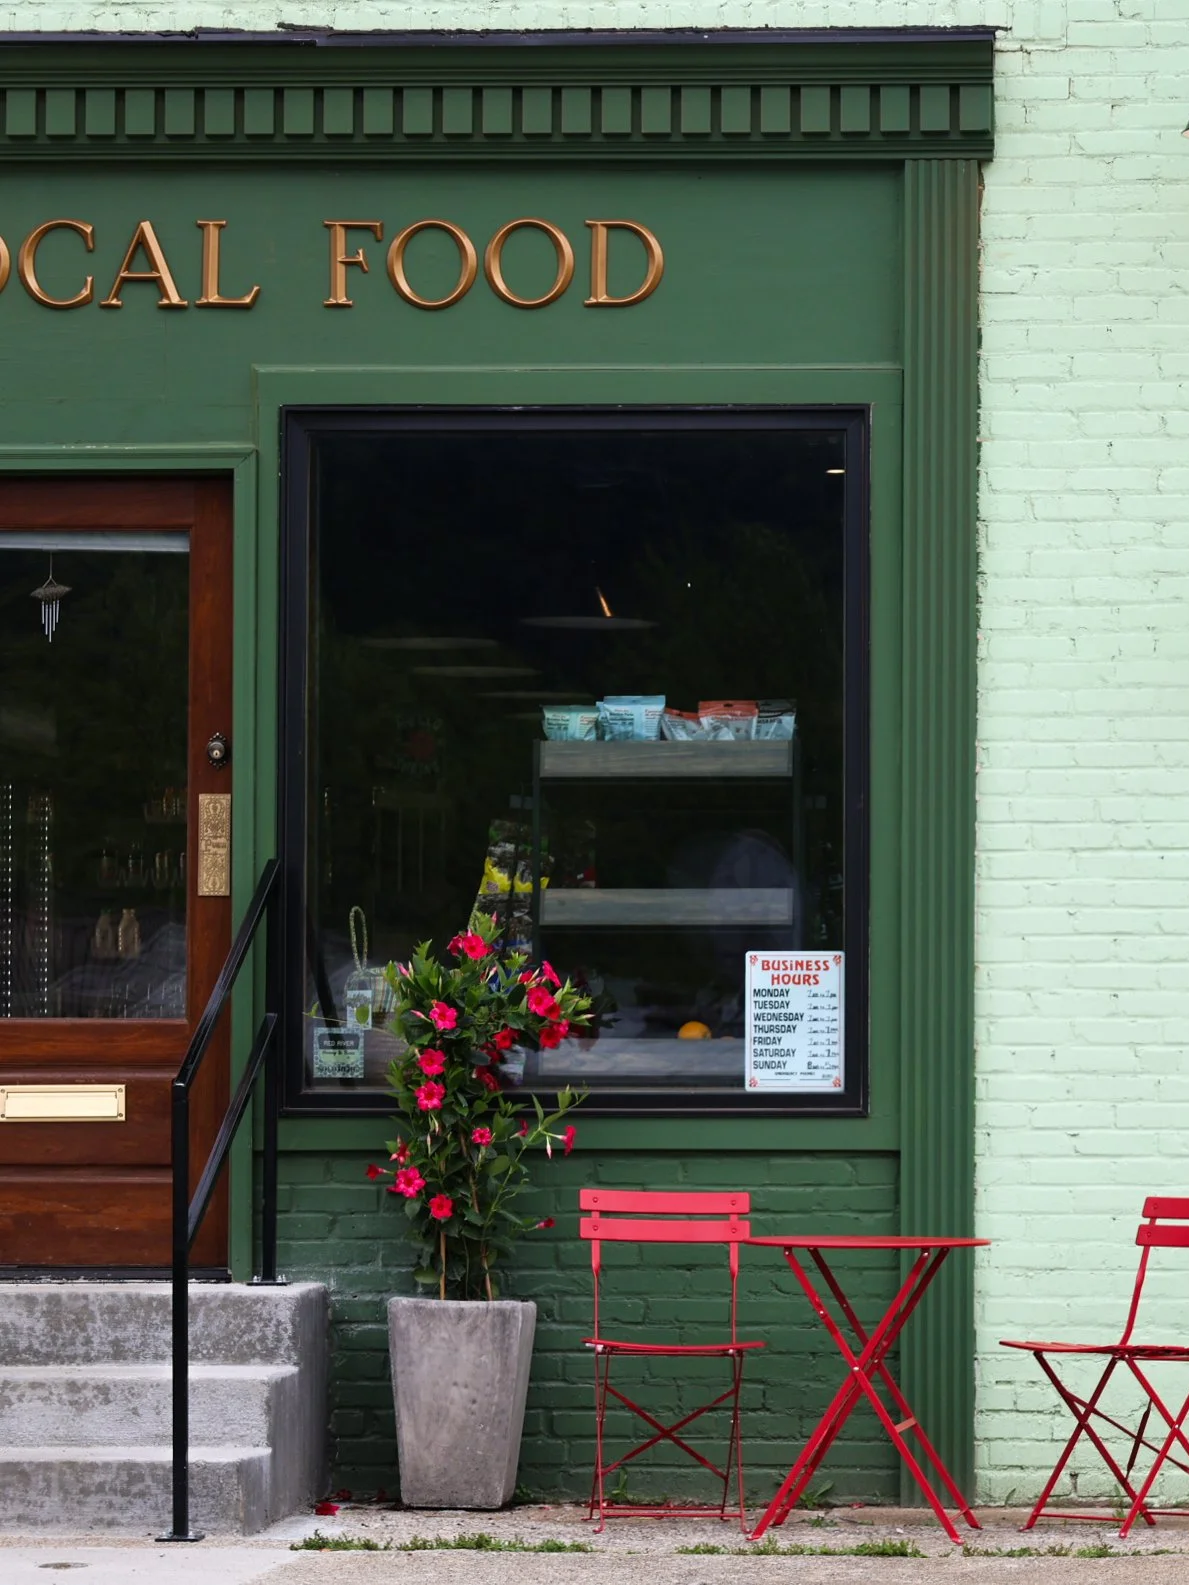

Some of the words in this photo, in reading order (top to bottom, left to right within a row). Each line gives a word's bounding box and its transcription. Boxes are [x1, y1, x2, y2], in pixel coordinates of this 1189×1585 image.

[0, 218, 260, 310] CAL
[323, 218, 665, 311] FOOD
[771, 973, 820, 986] HOURS
[753, 988, 790, 998] MONDAY
[753, 1000, 790, 1010] TUESDAY
[753, 1012, 804, 1022] WEDNESDAY
[753, 1024, 797, 1034] THURSDAY
[753, 1036, 782, 1046] FRIDAY
[753, 1048, 796, 1058] SATURDAY
[753, 1060, 787, 1070] SUNDAY
